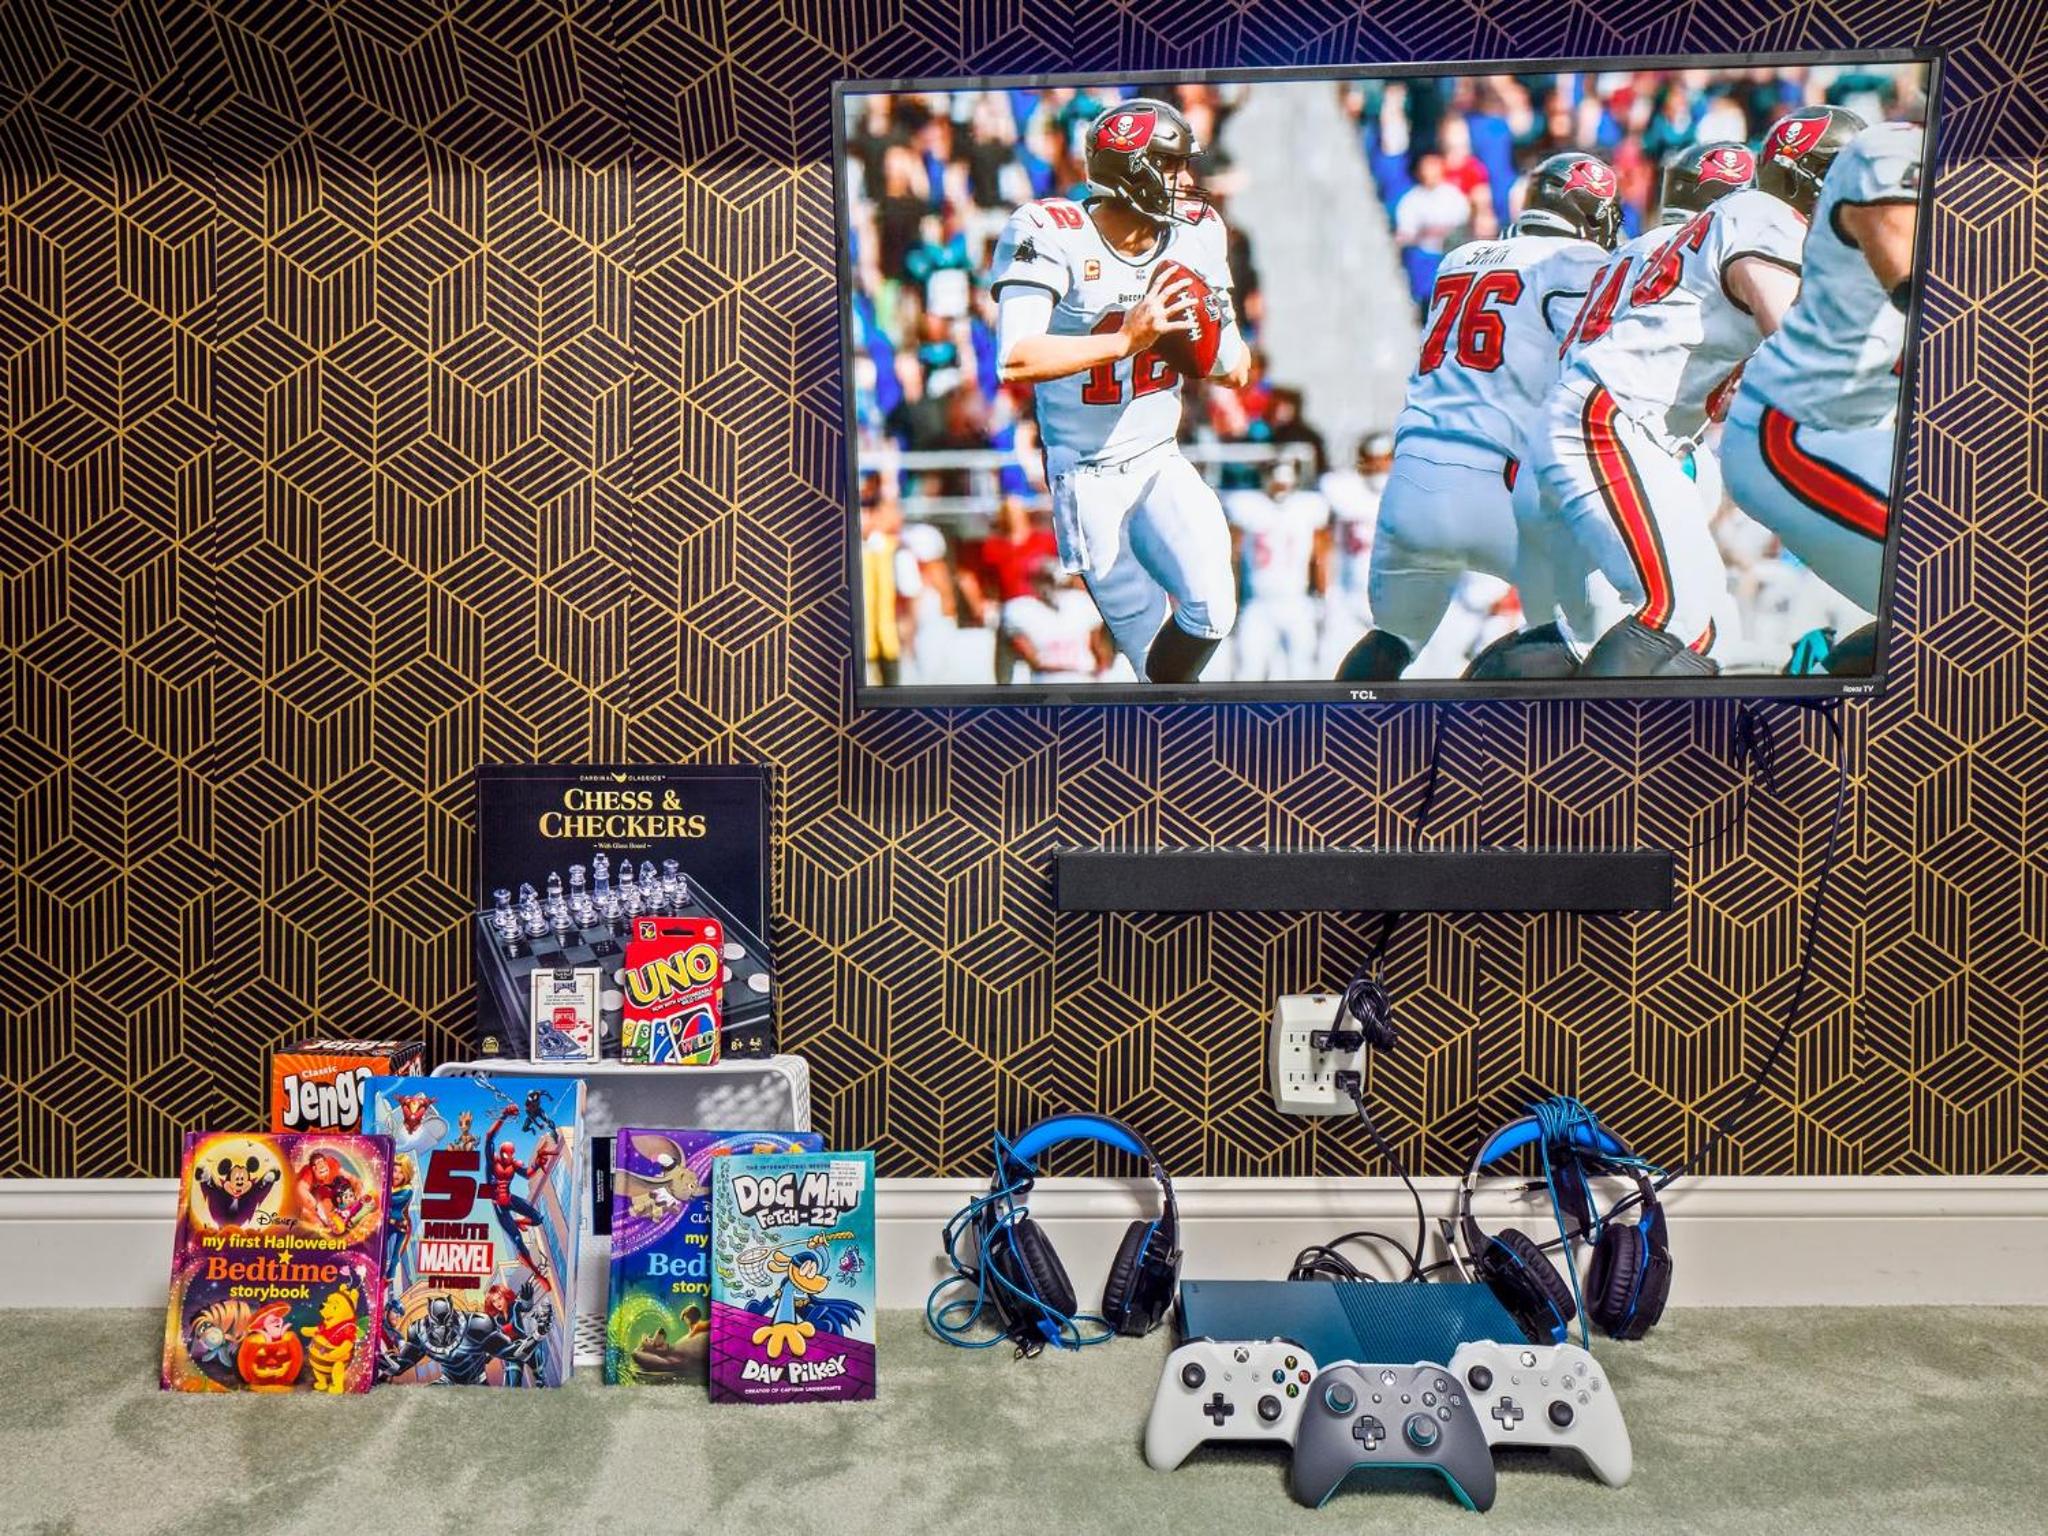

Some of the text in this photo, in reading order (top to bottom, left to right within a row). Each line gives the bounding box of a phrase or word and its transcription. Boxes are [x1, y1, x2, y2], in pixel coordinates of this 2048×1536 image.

[1420, 270, 1524, 376] 76
[1350, 690, 1377, 700] TCL
[1863, 684, 1874, 693] TV
[563, 787, 683, 812] CHESS &
[538, 811, 707, 839] CHECKERS
[625, 943, 720, 1006] UNO
[656, 1024, 666, 1037] 4
[680, 1030, 715, 1054] WILD
[301, 1065, 338, 1079] Classic
[731, 1172, 859, 1215] DOG MAN
[690, 1213, 711, 1223] CLA
[424, 1222, 489, 1240] MINUTE
[202, 1233, 347, 1251] my first Halloween
[684, 1233, 709, 1248] my
[421, 1243, 491, 1273] MARVEL
[646, 1252, 707, 1277] Bed
[205, 1256, 338, 1283] Bedtime
[229, 1284, 310, 1302] storybook
[672, 1281, 711, 1297] story
